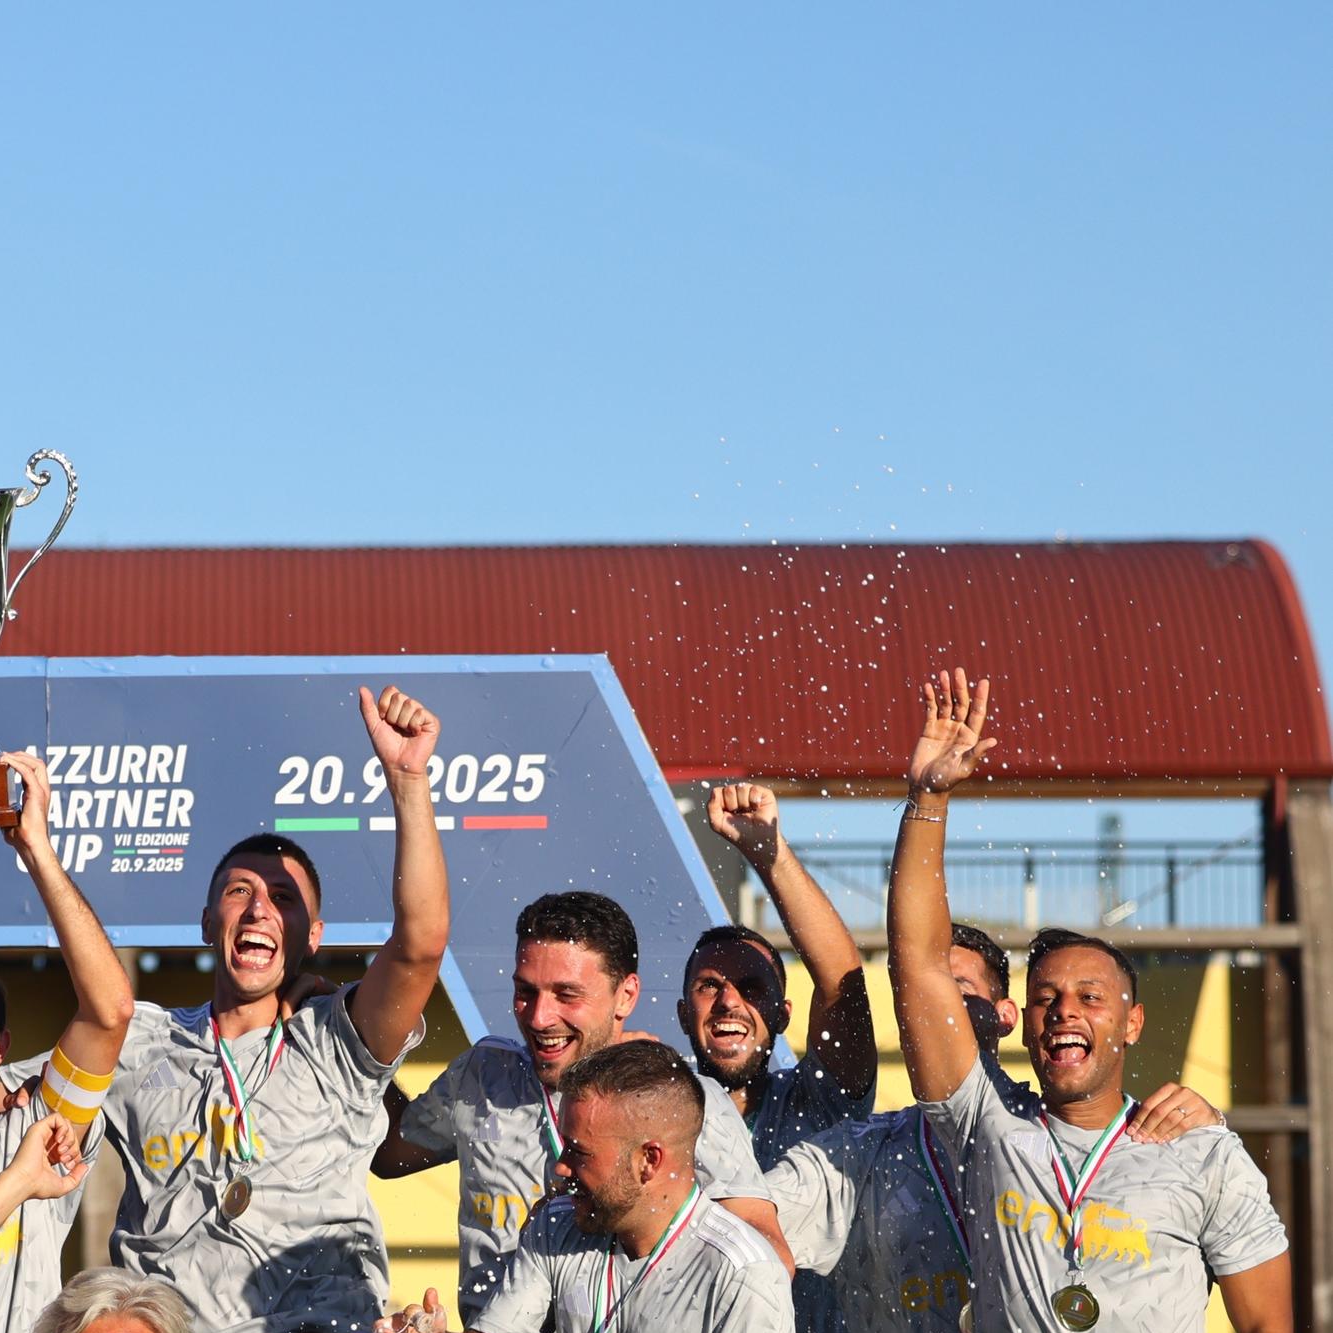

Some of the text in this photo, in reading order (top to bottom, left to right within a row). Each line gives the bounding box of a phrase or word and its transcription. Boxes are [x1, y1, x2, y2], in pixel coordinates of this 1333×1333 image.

[274, 753, 547, 805] 20.92025
[114, 832, 189, 847] VII EDIZIONE
[110, 856, 184, 873] 20.9.2025
